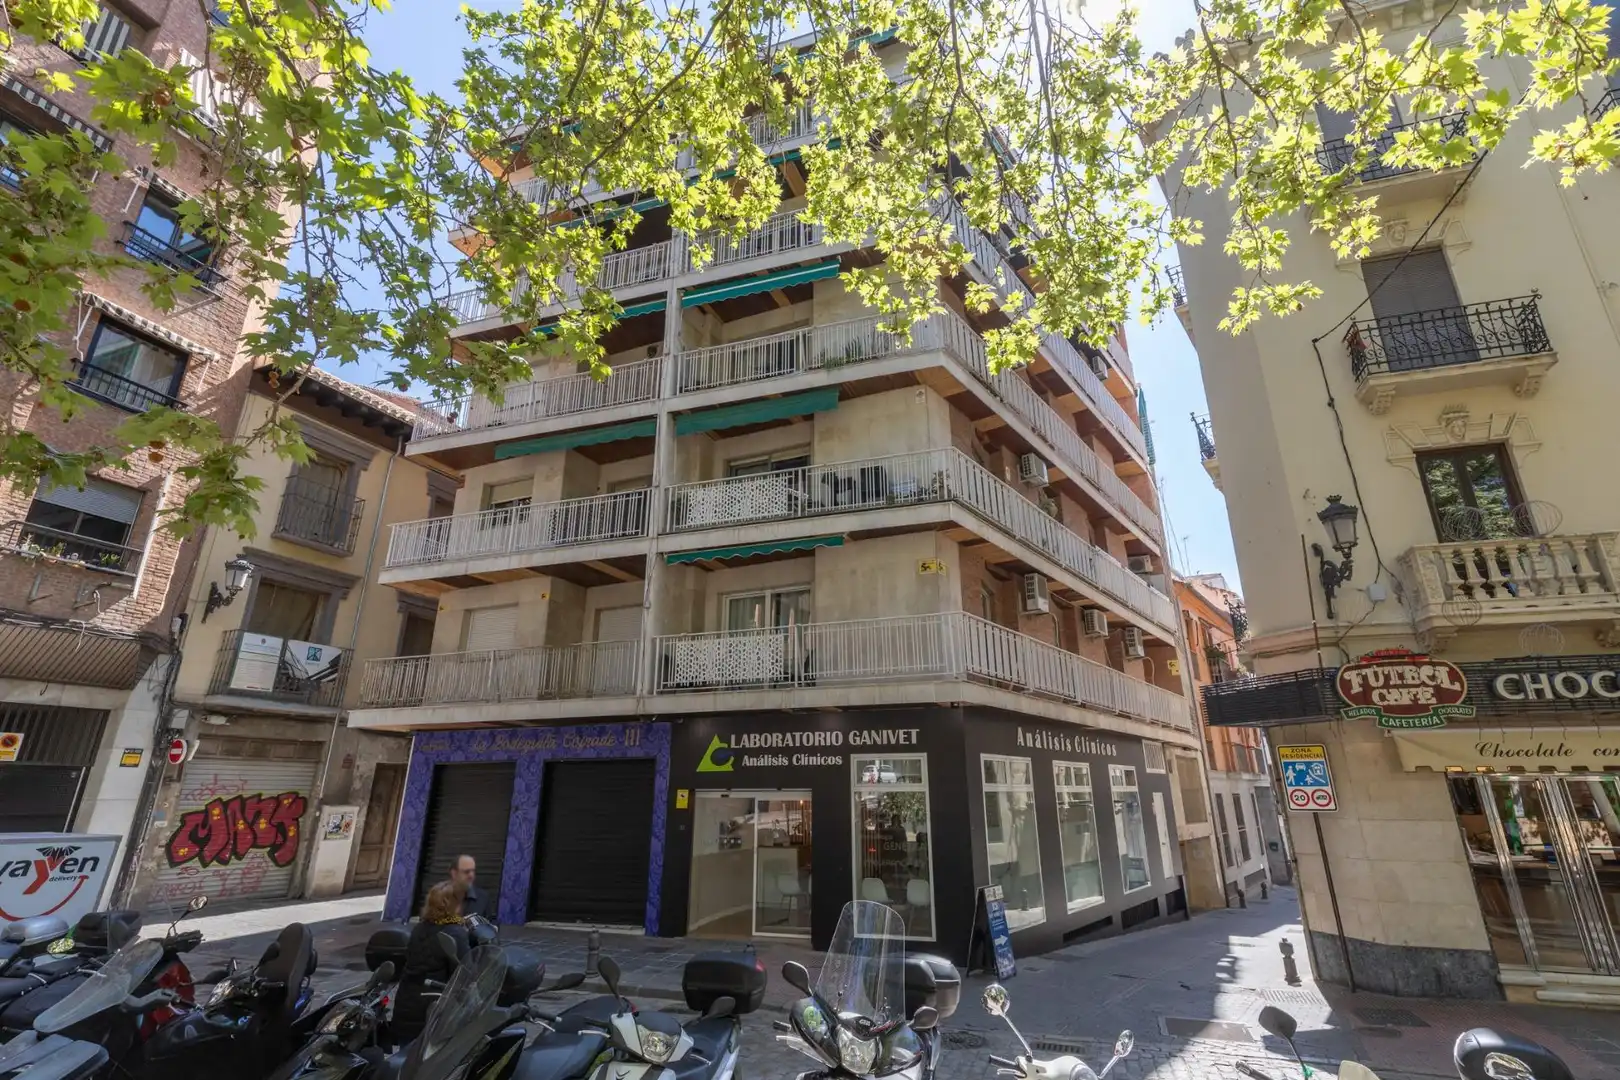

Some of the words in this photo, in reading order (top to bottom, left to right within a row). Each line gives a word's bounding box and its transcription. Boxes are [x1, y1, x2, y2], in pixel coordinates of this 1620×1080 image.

[1348, 708, 1377, 717] HELADOS
[1381, 714, 1441, 728] CAFETERÍA
[730, 730, 843, 749] LABORATORIO
[848, 728, 920, 746] GANIVET
[1017, 726, 1072, 752] Análisis
[1074, 734, 1117, 757] Clínicos
[1475, 741, 1577, 758] Chocolate
[742, 753, 789, 767] Análisis
[792, 752, 843, 766] Clínicos
[48, 874, 78, 882] delivery
